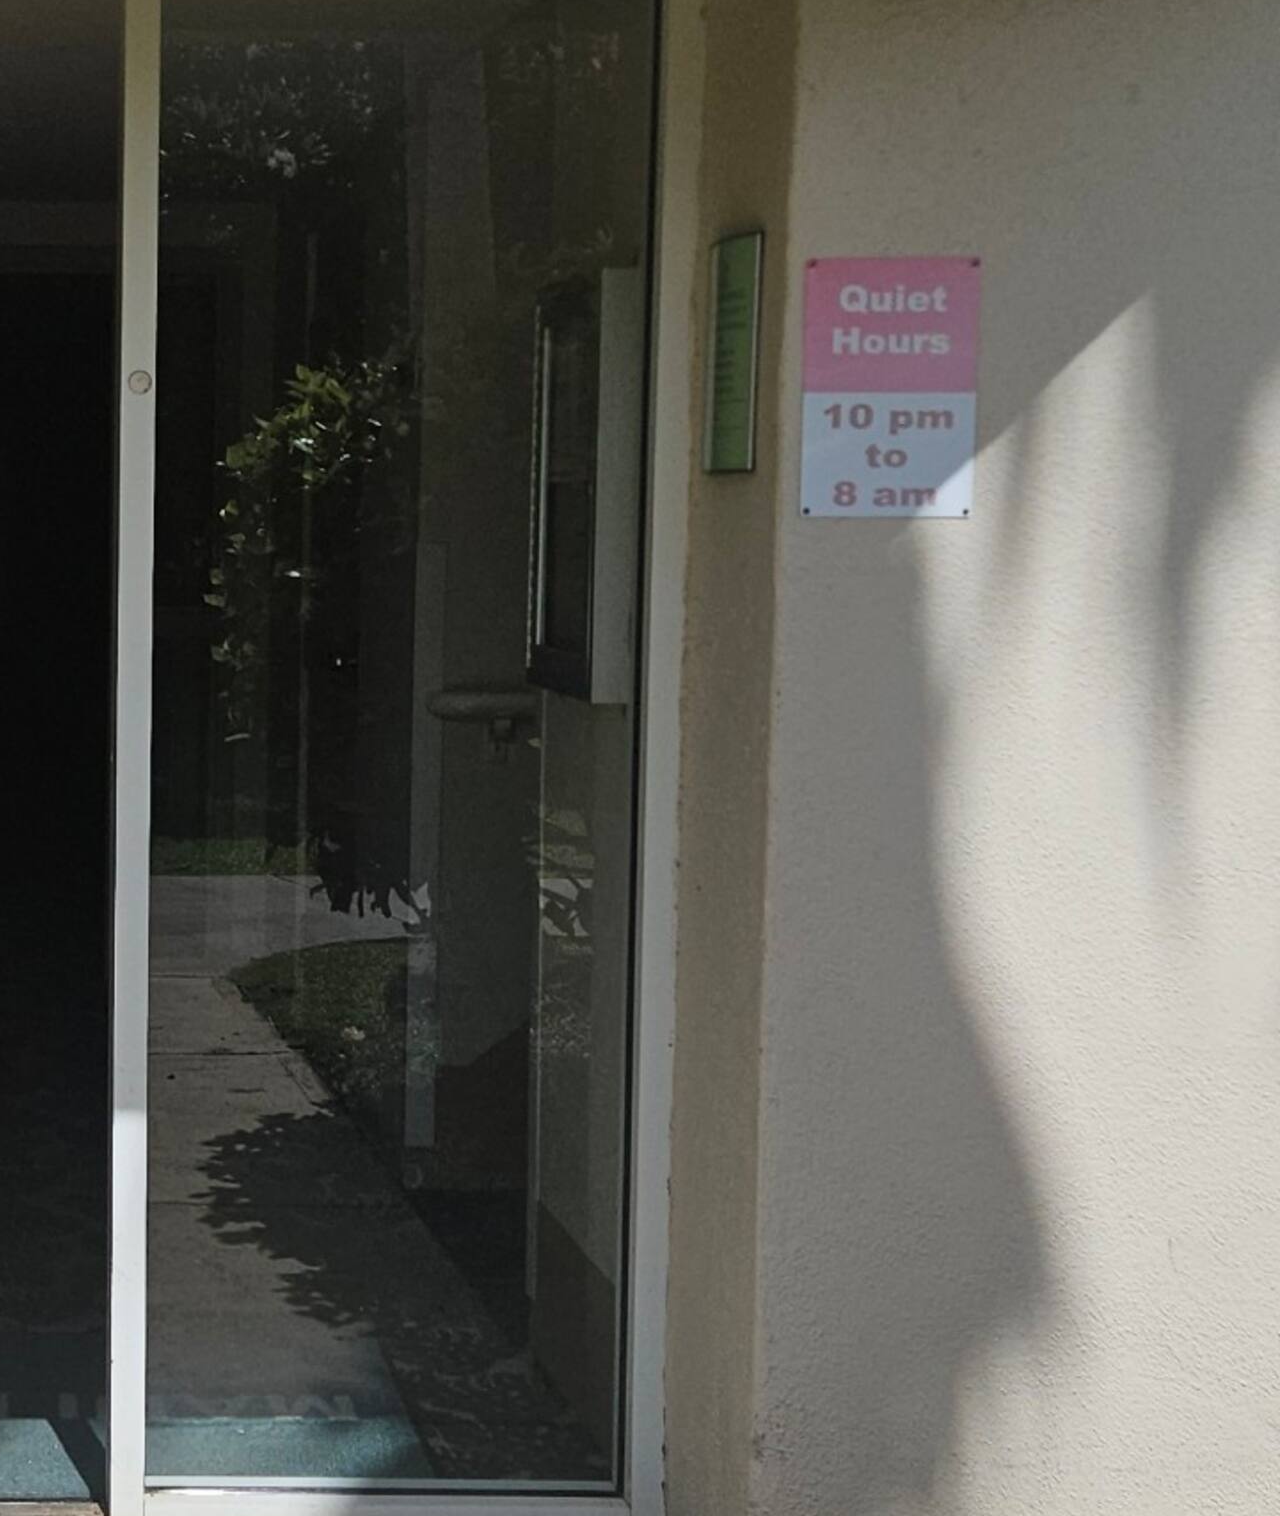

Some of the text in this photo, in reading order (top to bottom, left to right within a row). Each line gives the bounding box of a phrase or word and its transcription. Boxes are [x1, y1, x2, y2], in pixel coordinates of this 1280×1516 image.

[839, 285, 948, 313] Quiet
[832, 328, 951, 355] Hours
[824, 403, 954, 434] 10 pm
[865, 443, 908, 469] to
[833, 481, 939, 507] 8 am
